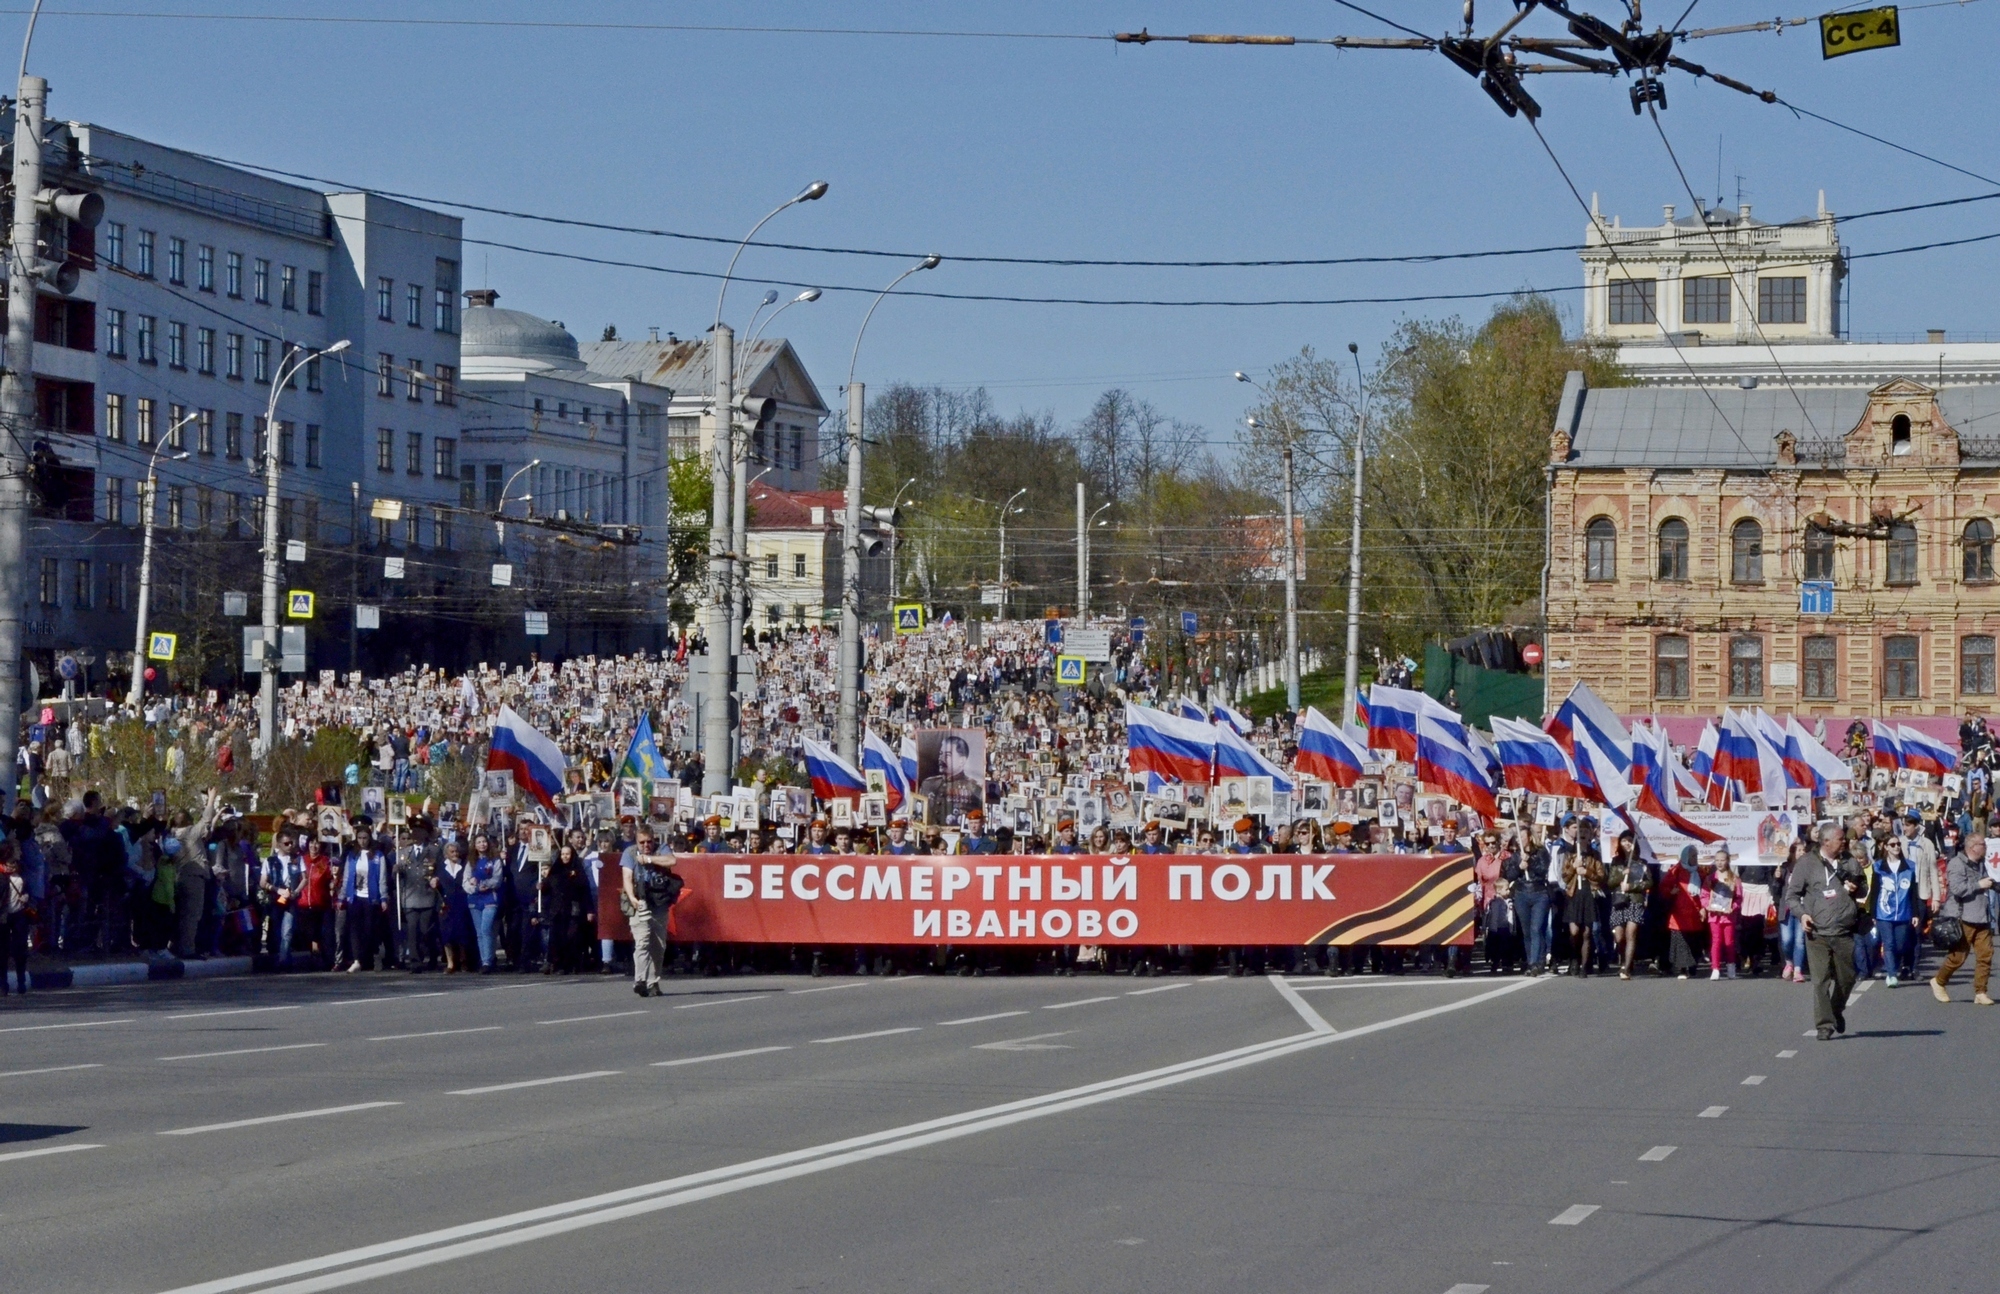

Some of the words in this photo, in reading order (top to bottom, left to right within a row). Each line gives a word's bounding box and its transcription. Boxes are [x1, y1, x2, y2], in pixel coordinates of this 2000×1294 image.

[723, 857, 1137, 901] БЕССМЕРТНЫЙ
[1169, 864, 1337, 901] ПОЛК
[913, 909, 1139, 938] ИВАНОВО
